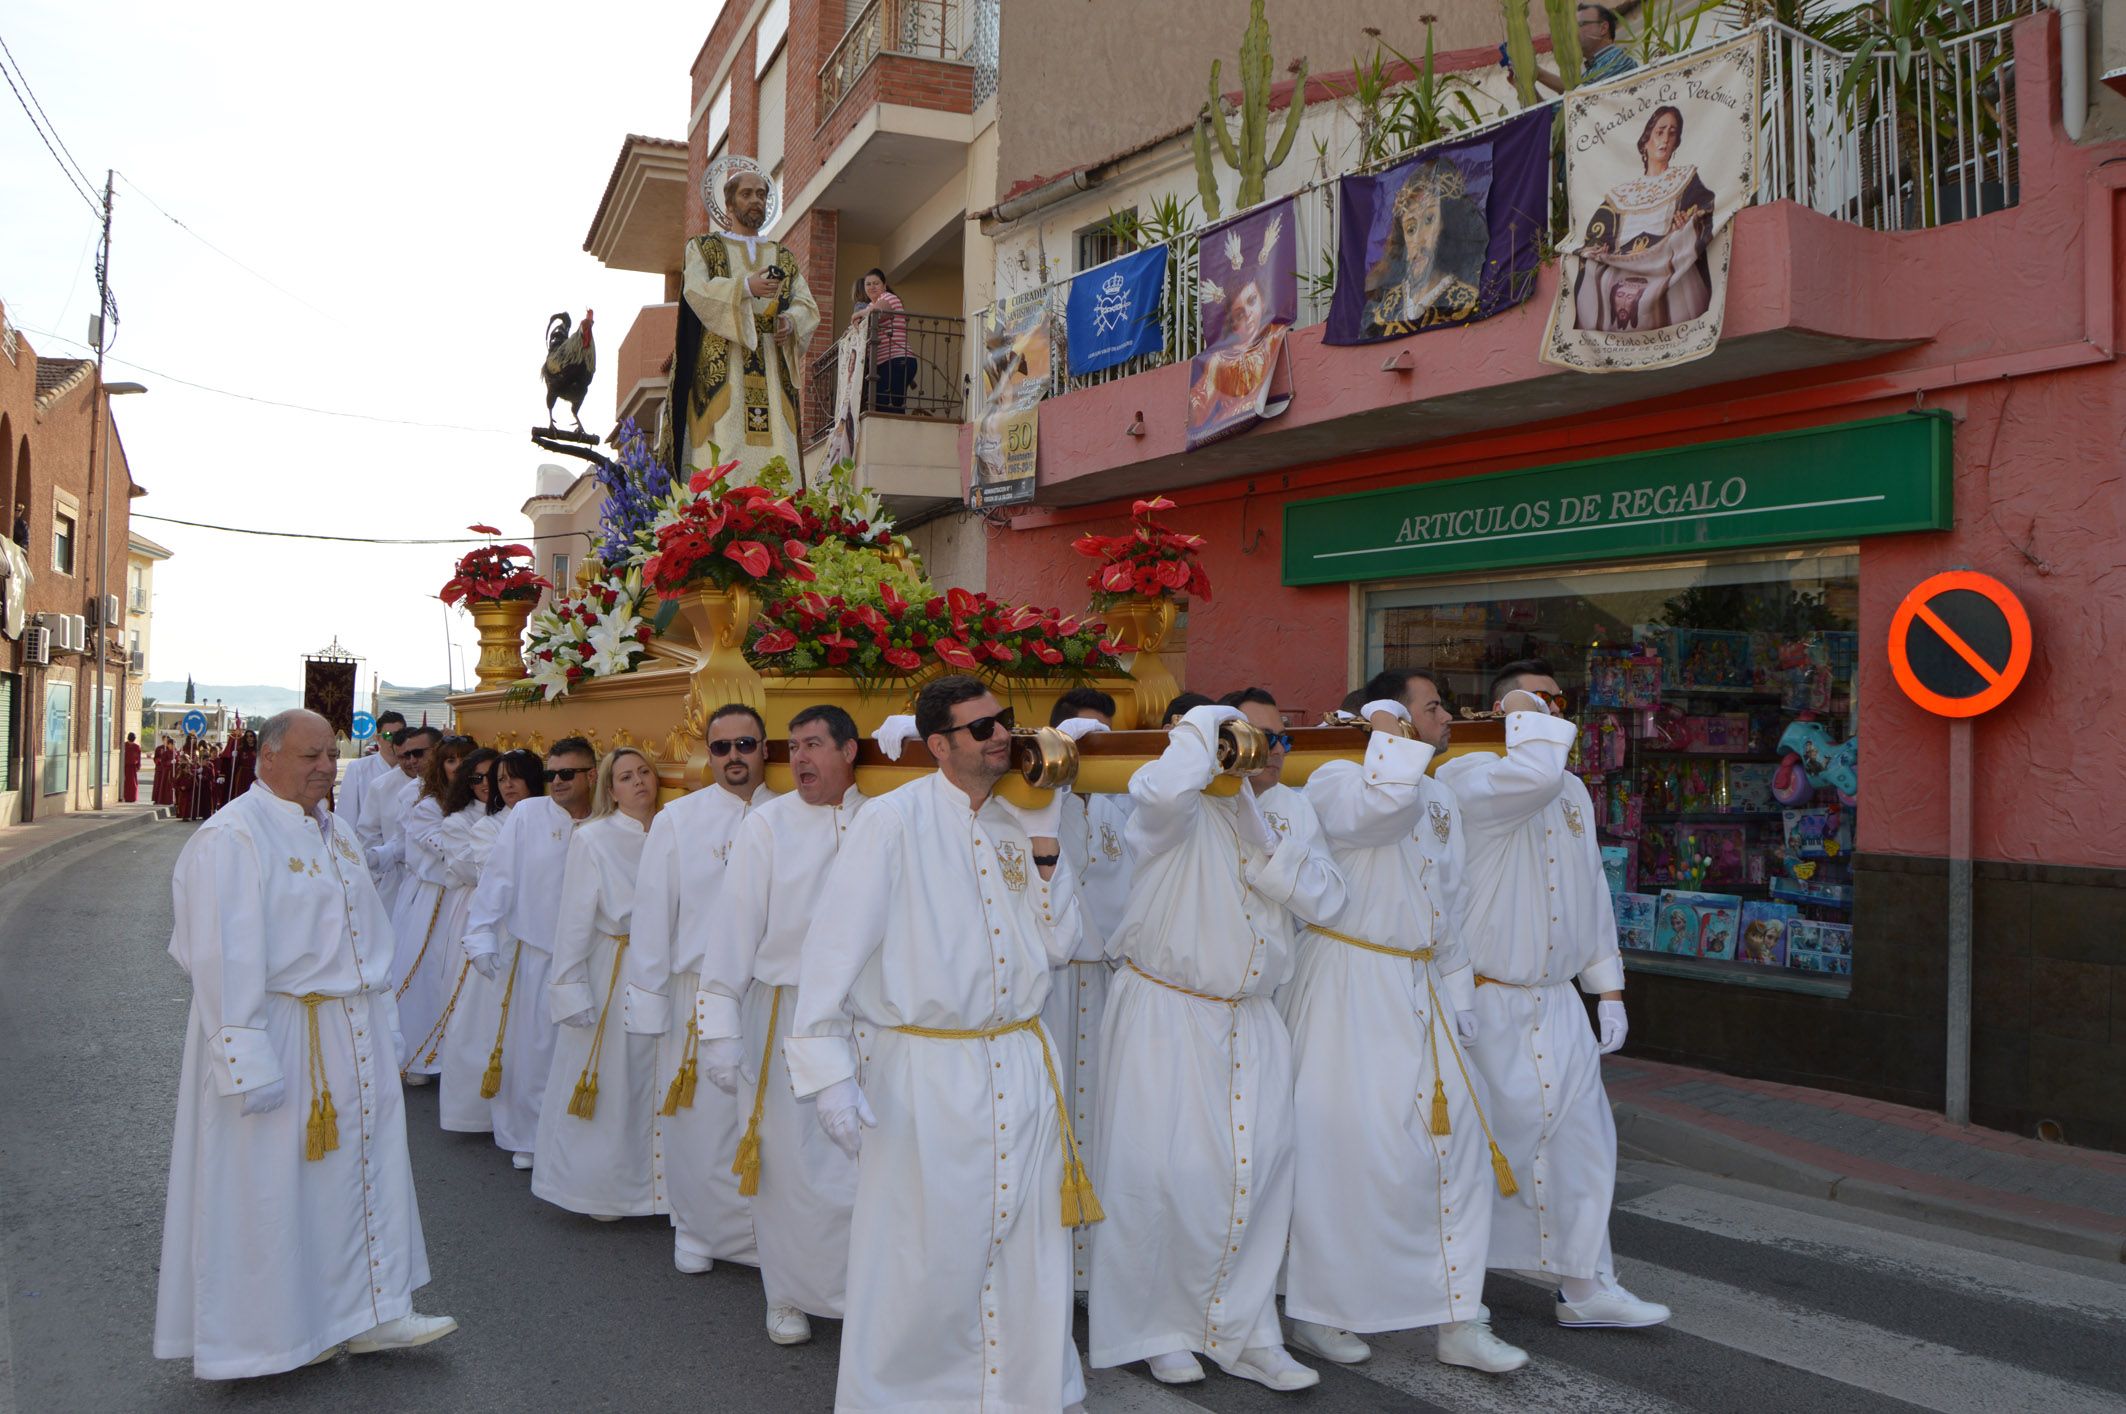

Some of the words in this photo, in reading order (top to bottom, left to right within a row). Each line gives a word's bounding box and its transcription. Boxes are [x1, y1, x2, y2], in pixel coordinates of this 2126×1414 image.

[1576, 106, 1636, 152] Cofradía
[1637, 97, 1652, 113] de
[1654, 83, 1678, 105] La
[1685, 80, 1738, 110] Verónica
[1604, 333, 1642, 347] Cristo
[1643, 334, 1657, 346] de
[1657, 329, 1673, 343] la
[1008, 422, 1033, 451] 50
[1395, 500, 1551, 543] ARTICULOS
[1557, 494, 1603, 526] DE
[1608, 476, 1748, 519] REGALO
